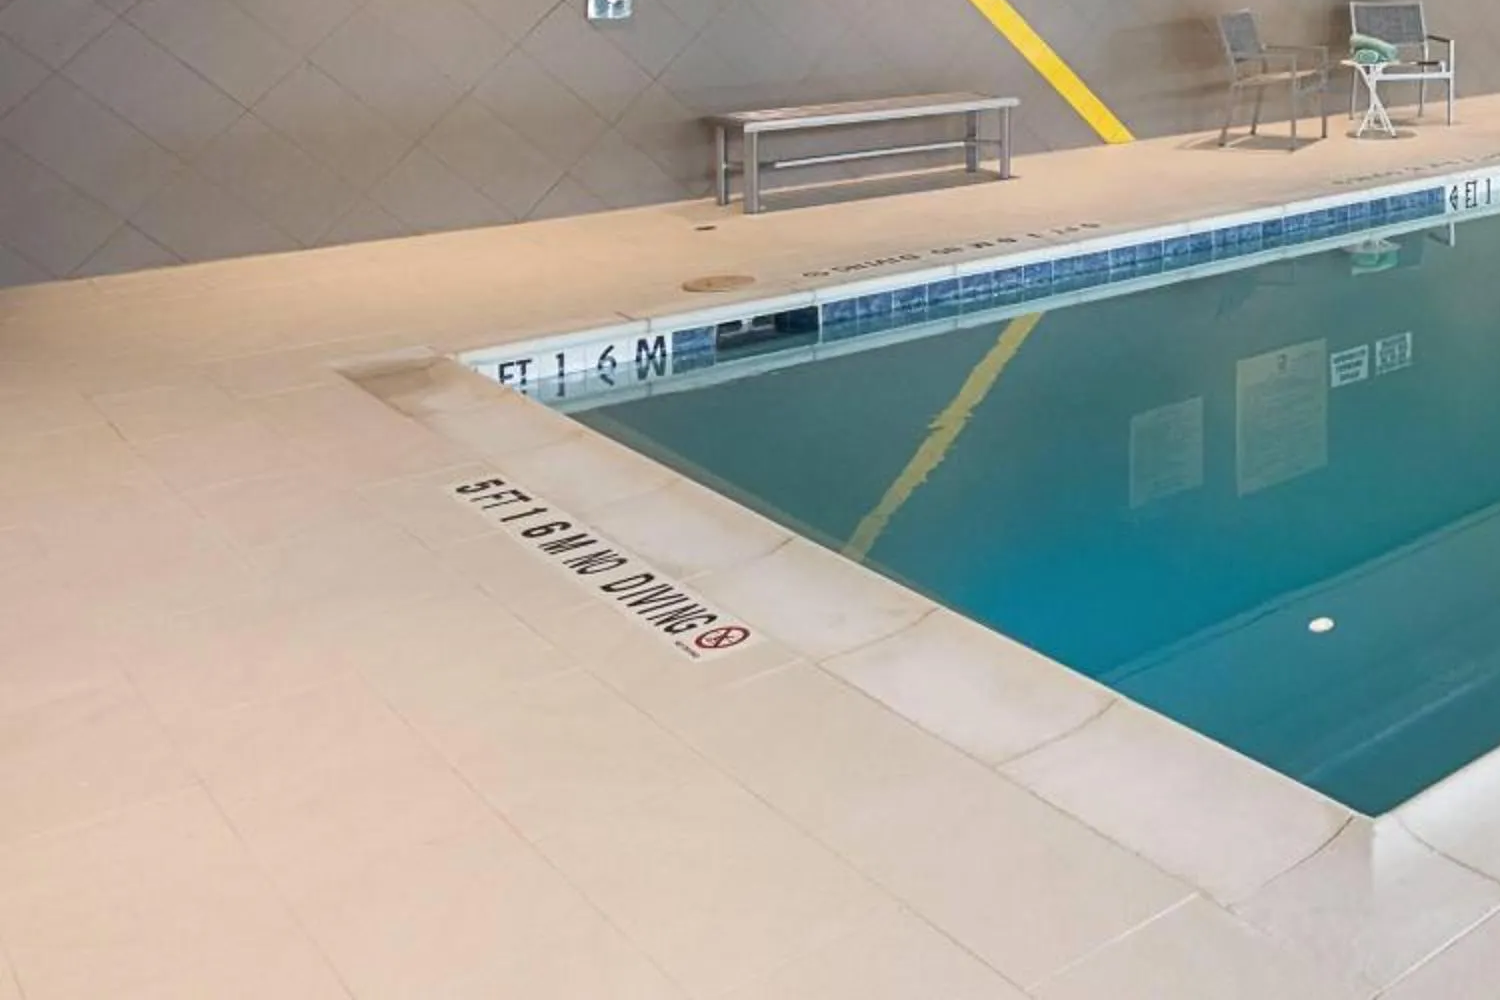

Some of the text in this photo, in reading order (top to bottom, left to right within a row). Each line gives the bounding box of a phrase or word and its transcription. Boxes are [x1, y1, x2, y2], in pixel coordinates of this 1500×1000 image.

[498, 358, 533, 385] FT
[555, 352, 565, 378] 1
[635, 335, 667, 364] M
[455, 477, 719, 636] 5 FT 1 6 M NO DIVING
